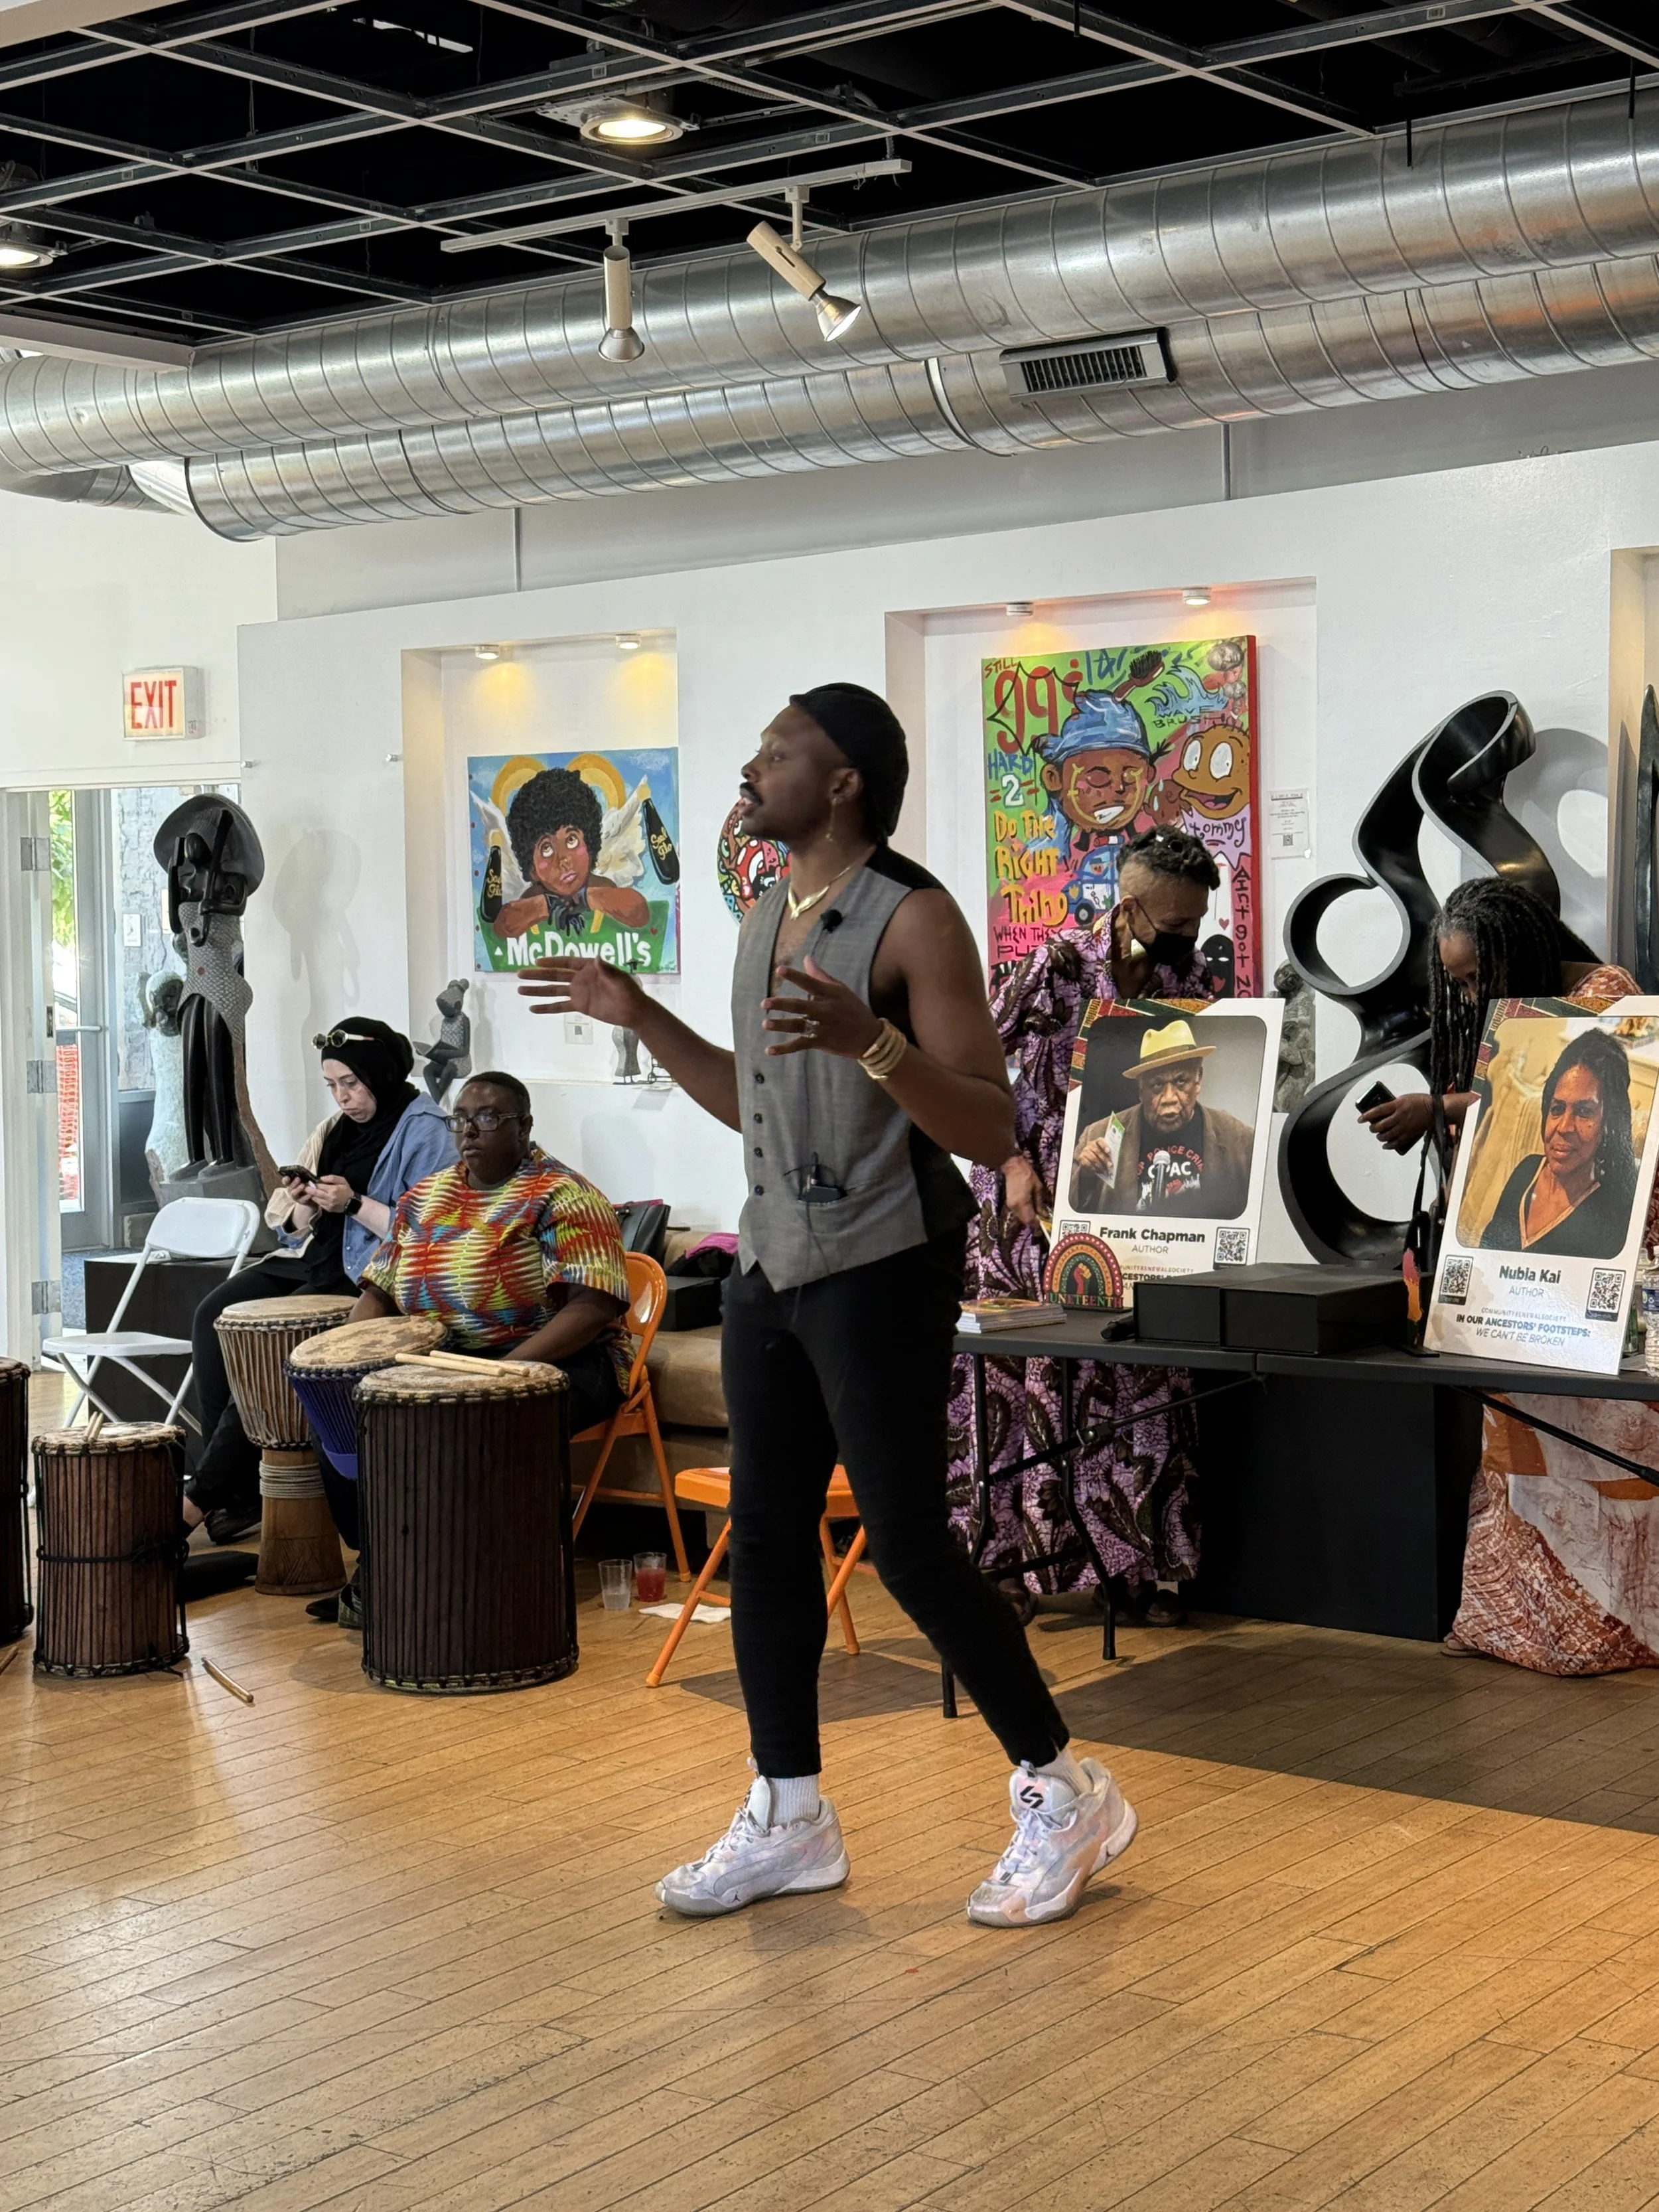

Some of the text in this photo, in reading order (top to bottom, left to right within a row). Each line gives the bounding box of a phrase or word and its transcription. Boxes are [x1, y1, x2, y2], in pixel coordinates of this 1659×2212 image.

[984, 658, 1019, 678] STILL
[130, 680, 177, 729] EXIT
[1159, 705, 1214, 718] WAVE
[1153, 713, 1225, 729] BRUSH
[987, 749, 1034, 781] HARD
[1001, 773, 1025, 808] 2
[1189, 816, 1247, 848] tommy
[993, 926, 1027, 944] WHEN
[506, 930, 652, 967] McDowell's
[1147, 1161, 1192, 1179] CAC
[1099, 1226, 1206, 1243] Frank Chapman
[1131, 1244, 1169, 1254] AUTHOR
[1498, 1265, 1561, 1284] Nubia Kai
[1508, 1286, 1545, 1298] AUTHOR
[1456, 1313, 1592, 1338] IN OUR ANCESTORS' FOOTSTEPS:
[1475, 1327, 1566, 1347] WE CAN'T BE BROKEN
